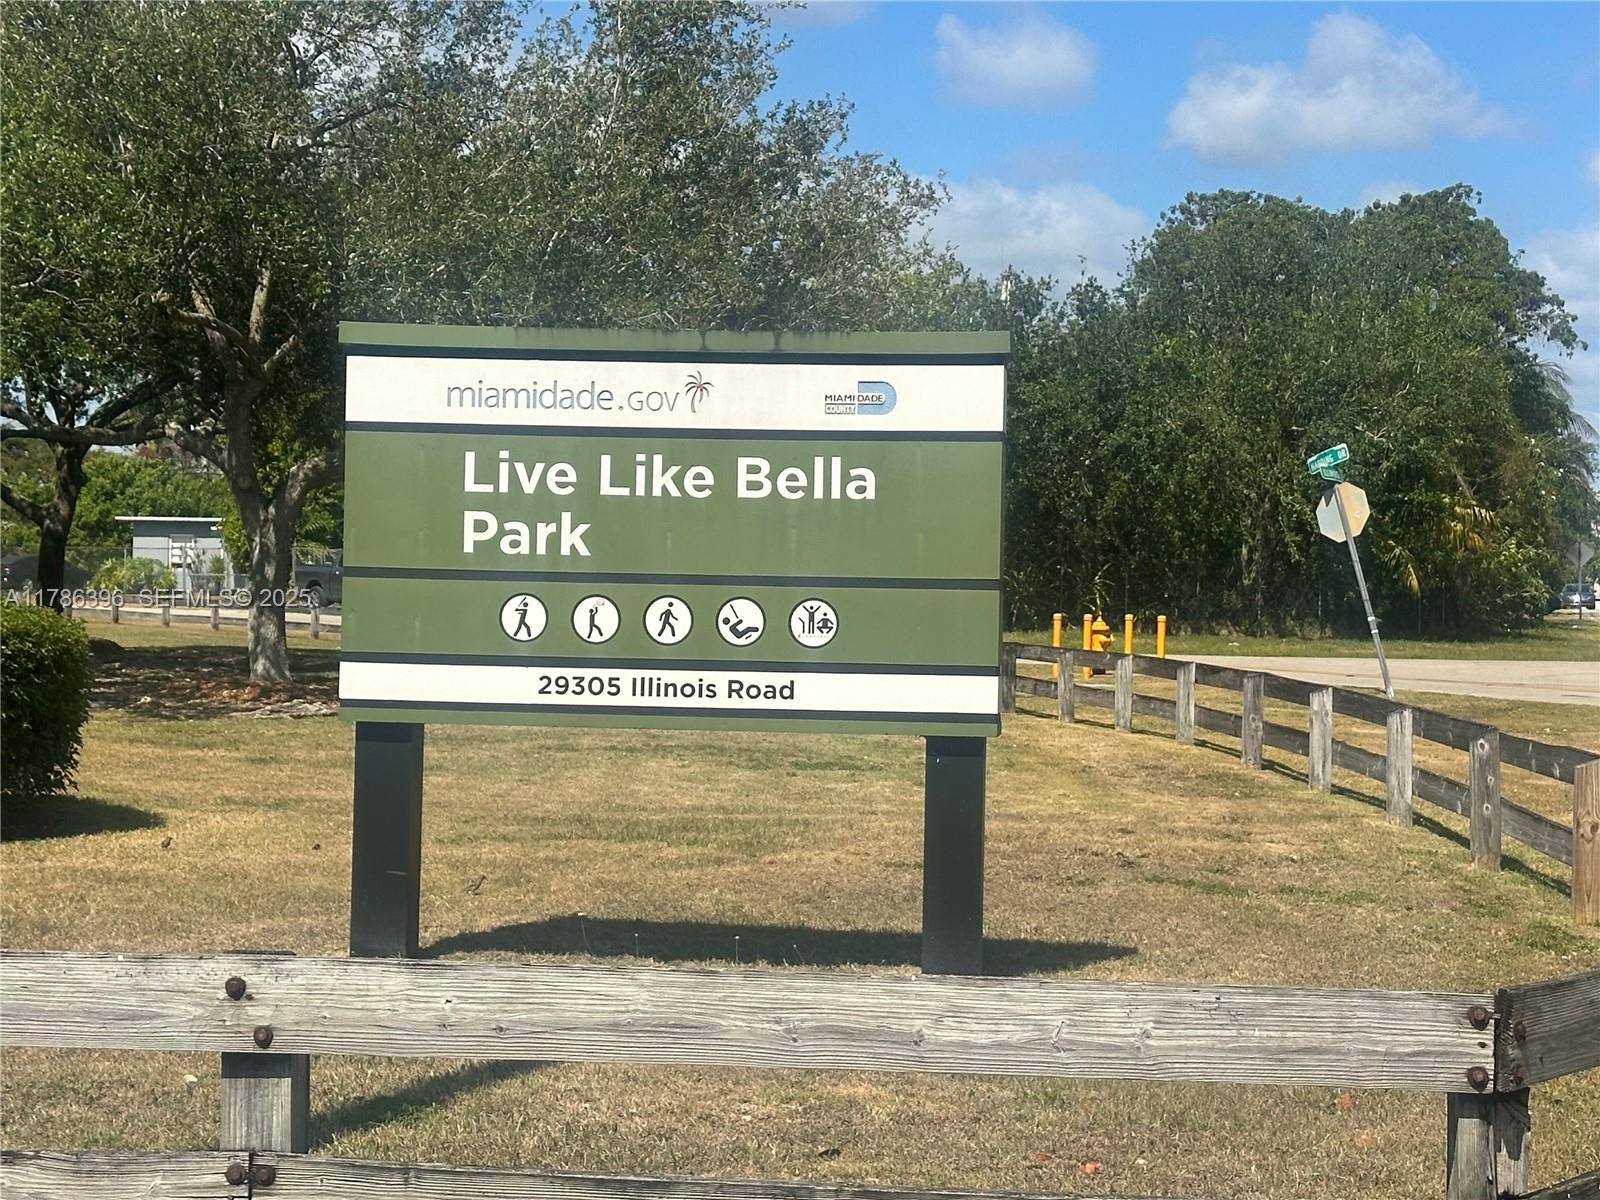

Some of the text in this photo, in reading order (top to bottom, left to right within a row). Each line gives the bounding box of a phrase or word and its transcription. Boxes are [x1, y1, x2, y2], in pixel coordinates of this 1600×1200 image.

[447, 379, 680, 412] miamidade.GOV
[824, 394, 884, 403] MIAMI DADE
[825, 404, 856, 414] COUNTY
[463, 450, 877, 501] Live Like Bella
[462, 510, 592, 557] Park
[537, 675, 796, 701] 29305 Illinois Road
